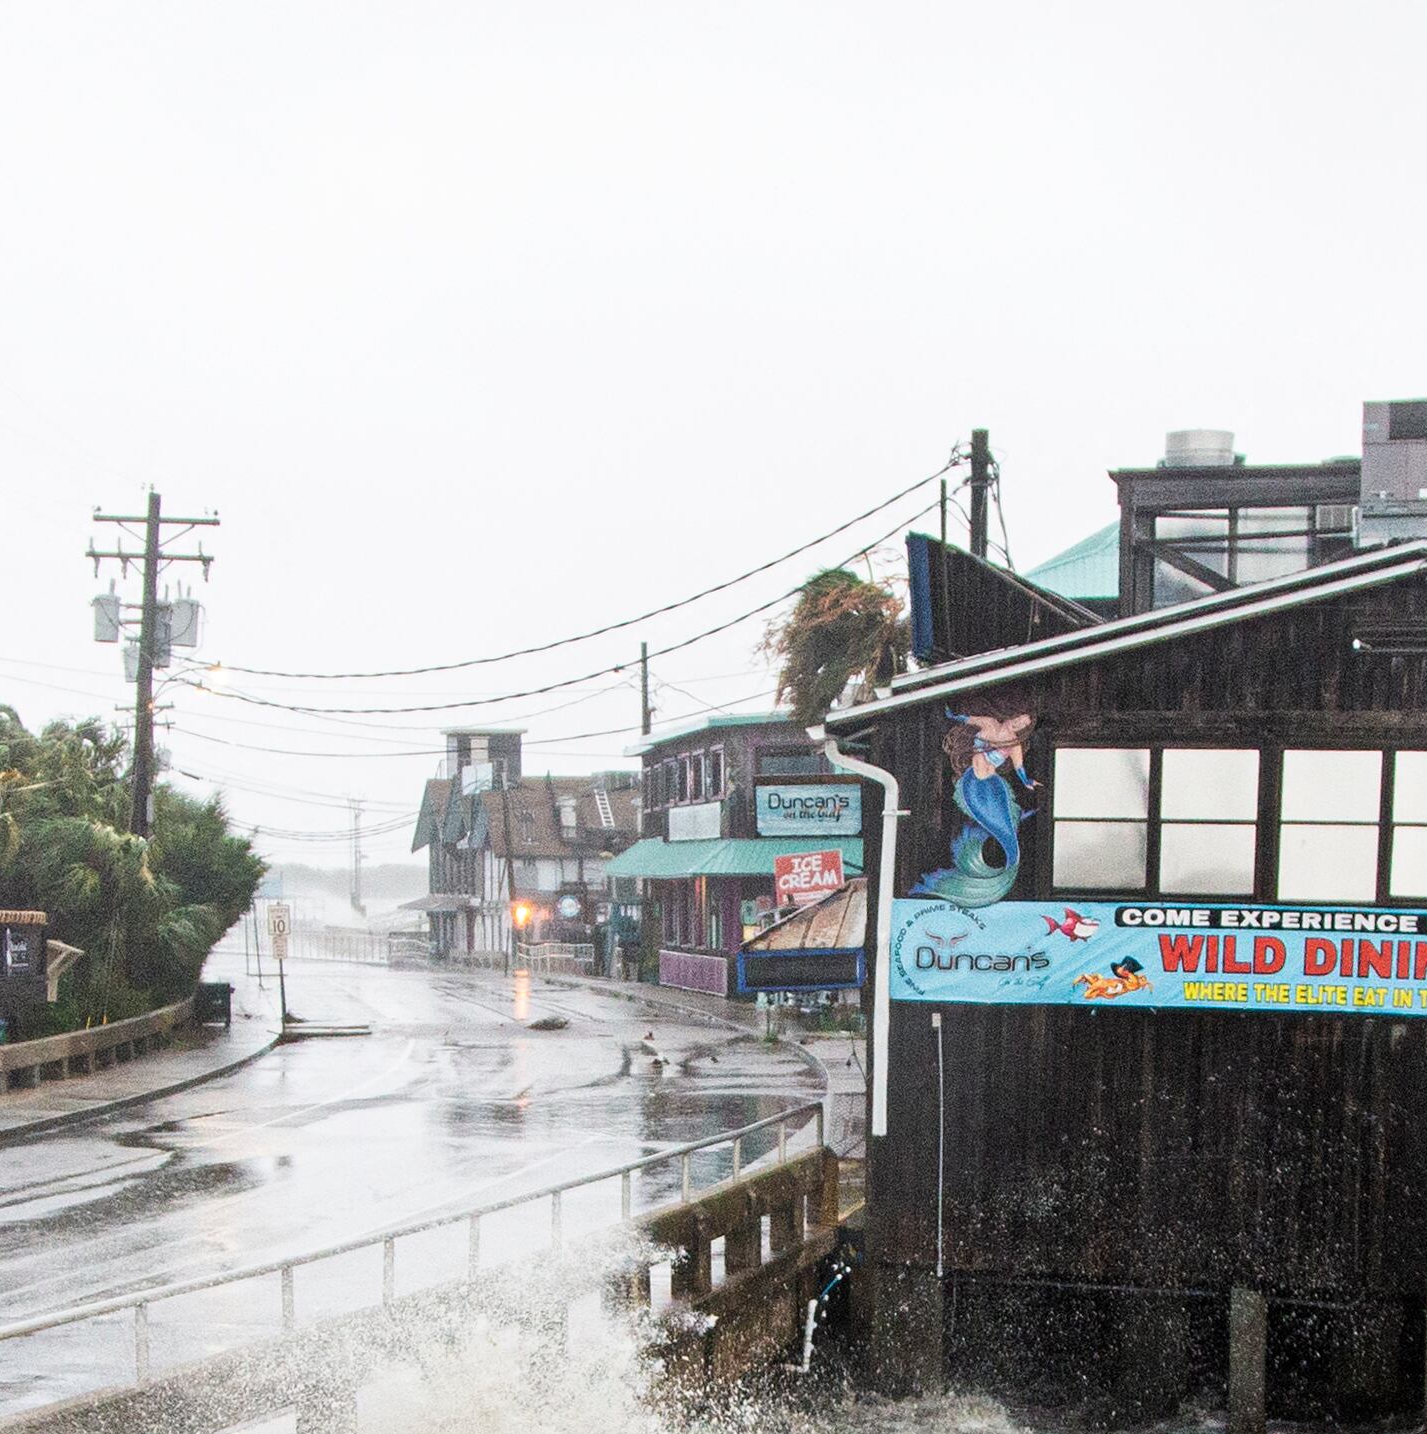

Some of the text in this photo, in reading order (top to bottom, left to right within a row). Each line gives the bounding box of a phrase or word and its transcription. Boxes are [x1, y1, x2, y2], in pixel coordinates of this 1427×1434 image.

[768, 793, 849, 810] Duncan's
[791, 854, 823, 873] ICE
[779, 869, 839, 889] CREAM
[273, 919, 286, 934] 10
[1121, 908, 1211, 928] COME
[1220, 909, 1419, 933] EXPERIENCE
[894, 928, 907, 977] SEAFOOD
[914, 904, 946, 920] PRIME
[949, 905, 987, 930] STEAKS
[916, 946, 1051, 972] Duncan's
[1158, 934, 1287, 976] WILD
[1183, 981, 1248, 1003] WHERE
[1254, 983, 1292, 1004] THE
[1296, 984, 1348, 1005] ELITE
[1353, 986, 1389, 1007] EAT
[1393, 987, 1413, 1008] IN
